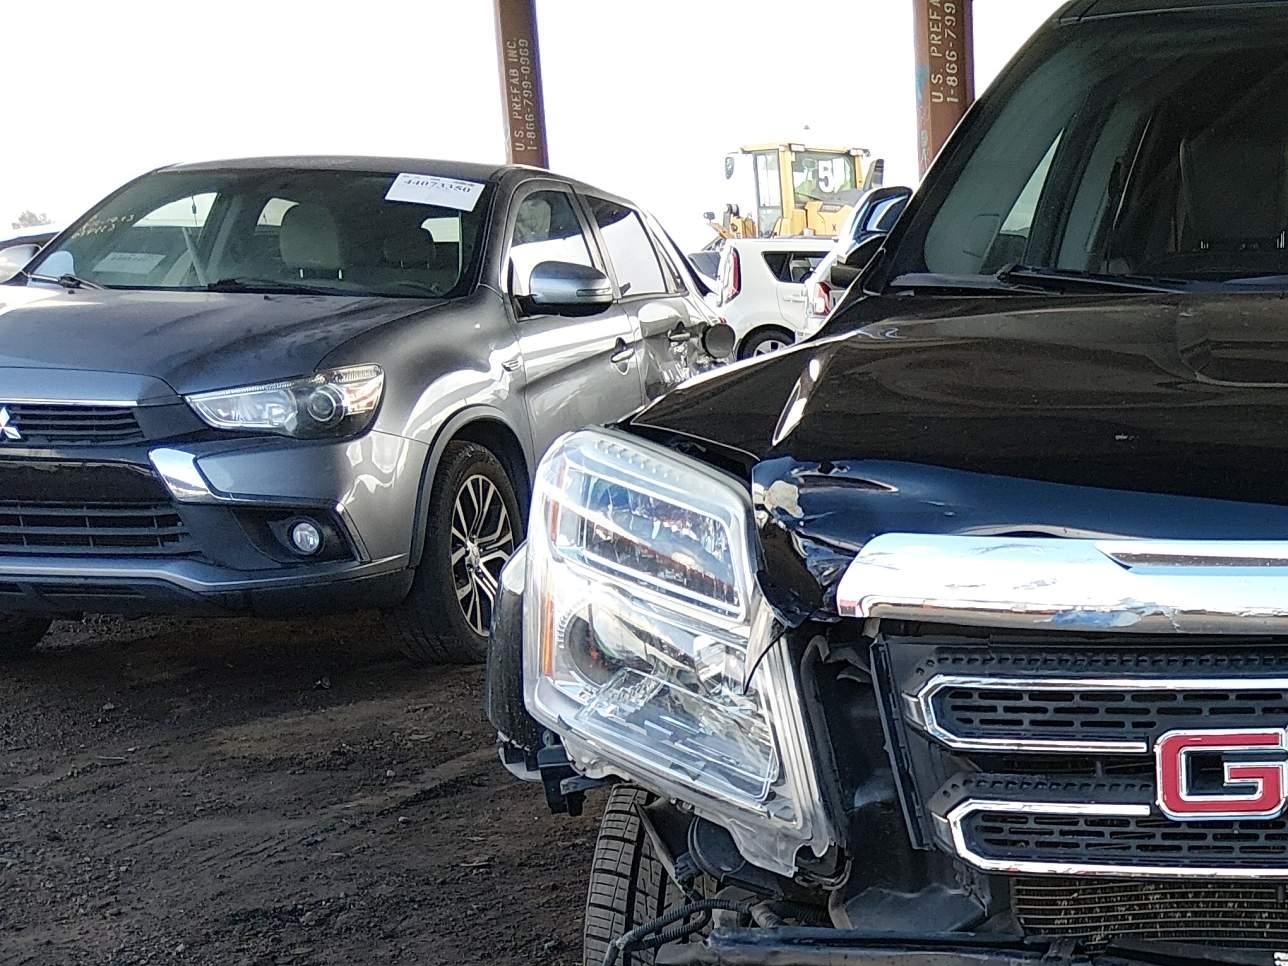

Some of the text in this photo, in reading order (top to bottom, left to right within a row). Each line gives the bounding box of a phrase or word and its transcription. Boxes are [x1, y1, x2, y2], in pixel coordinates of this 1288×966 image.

[506, 37, 526, 151] U.S. PREFAB INC.
[931, 68, 944, 103] U.S.
[943, 2, 959, 103] 1-866-799
